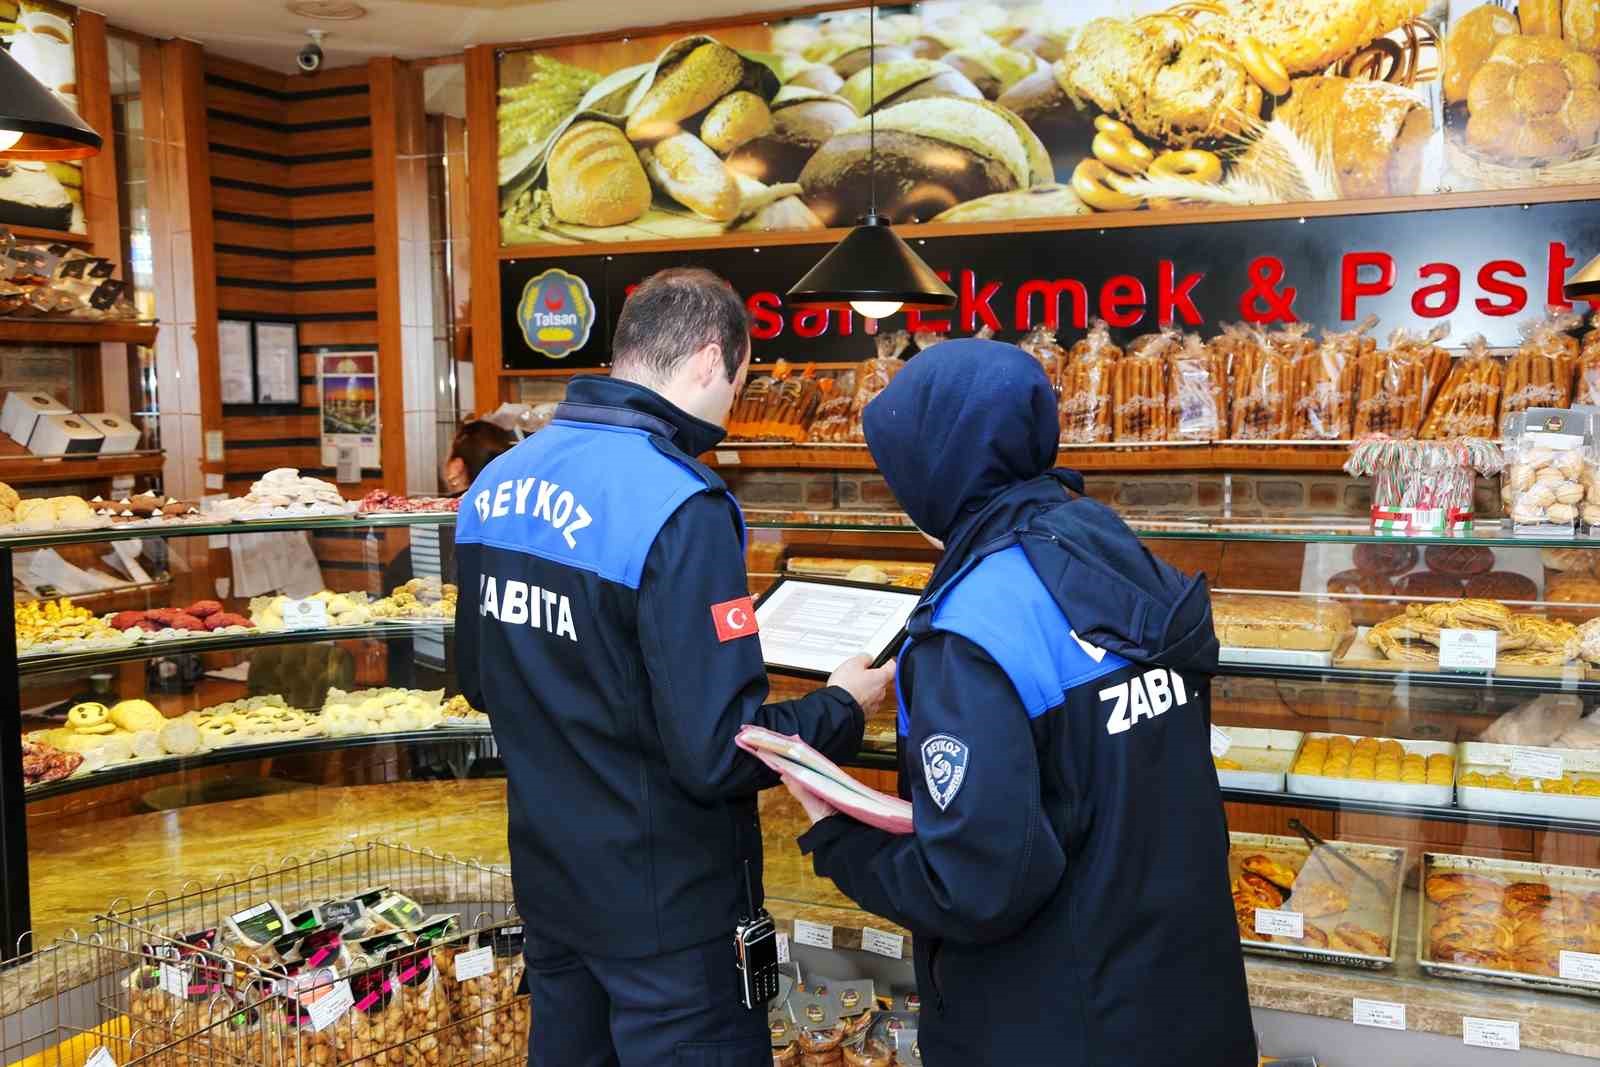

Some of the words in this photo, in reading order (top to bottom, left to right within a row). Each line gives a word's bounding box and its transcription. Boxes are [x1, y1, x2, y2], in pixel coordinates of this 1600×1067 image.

[1238, 255, 1301, 325] &
[1340, 241, 1600, 321] Past
[474, 477, 593, 550] BEYKOZ
[1098, 667, 1199, 735] ZABI
